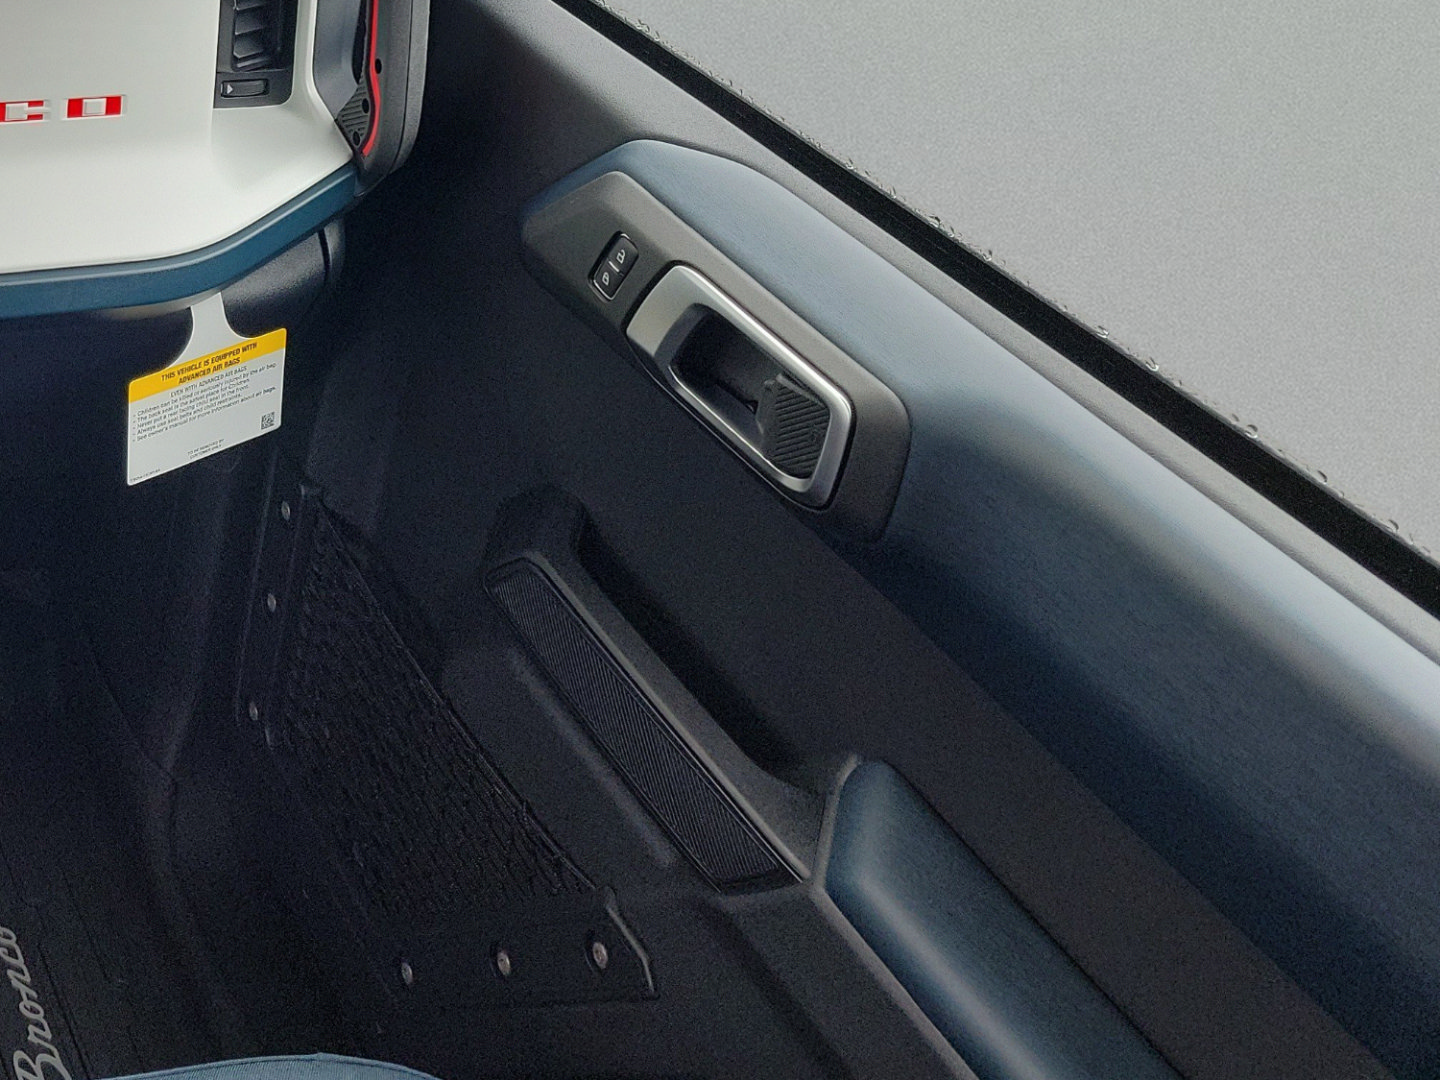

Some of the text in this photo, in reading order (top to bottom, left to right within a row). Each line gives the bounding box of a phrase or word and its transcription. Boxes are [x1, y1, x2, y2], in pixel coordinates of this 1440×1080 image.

[162, 372, 175, 382] THIS
[177, 362, 202, 376] VEHICLE
[211, 348, 240, 364] EQUIPPED
[242, 342, 257, 352] WITH
[178, 357, 240, 385] ADVANCED AIR BAGS
